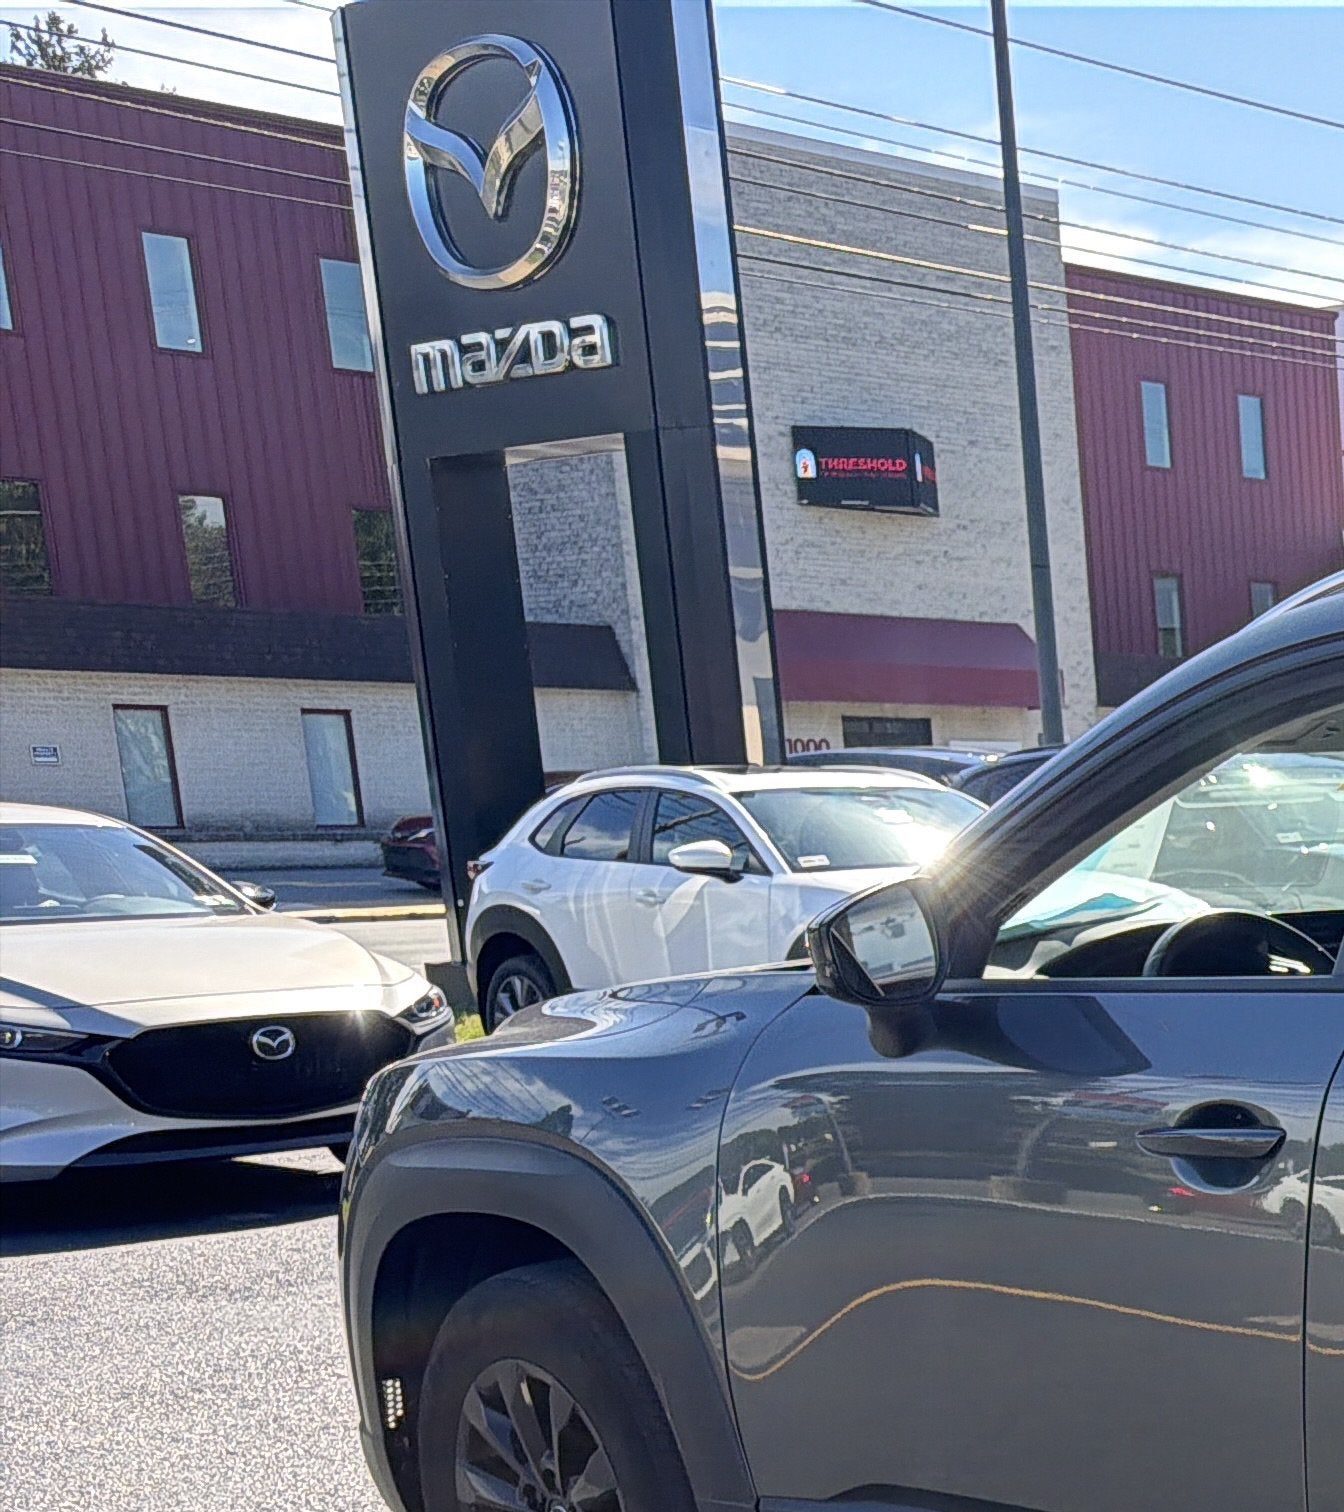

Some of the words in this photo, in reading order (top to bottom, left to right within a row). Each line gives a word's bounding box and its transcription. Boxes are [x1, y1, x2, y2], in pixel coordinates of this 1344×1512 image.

[411, 314, 613, 395] mazda
[818, 457, 908, 472] THRESHOLD
[786, 738, 830, 754] 1000
